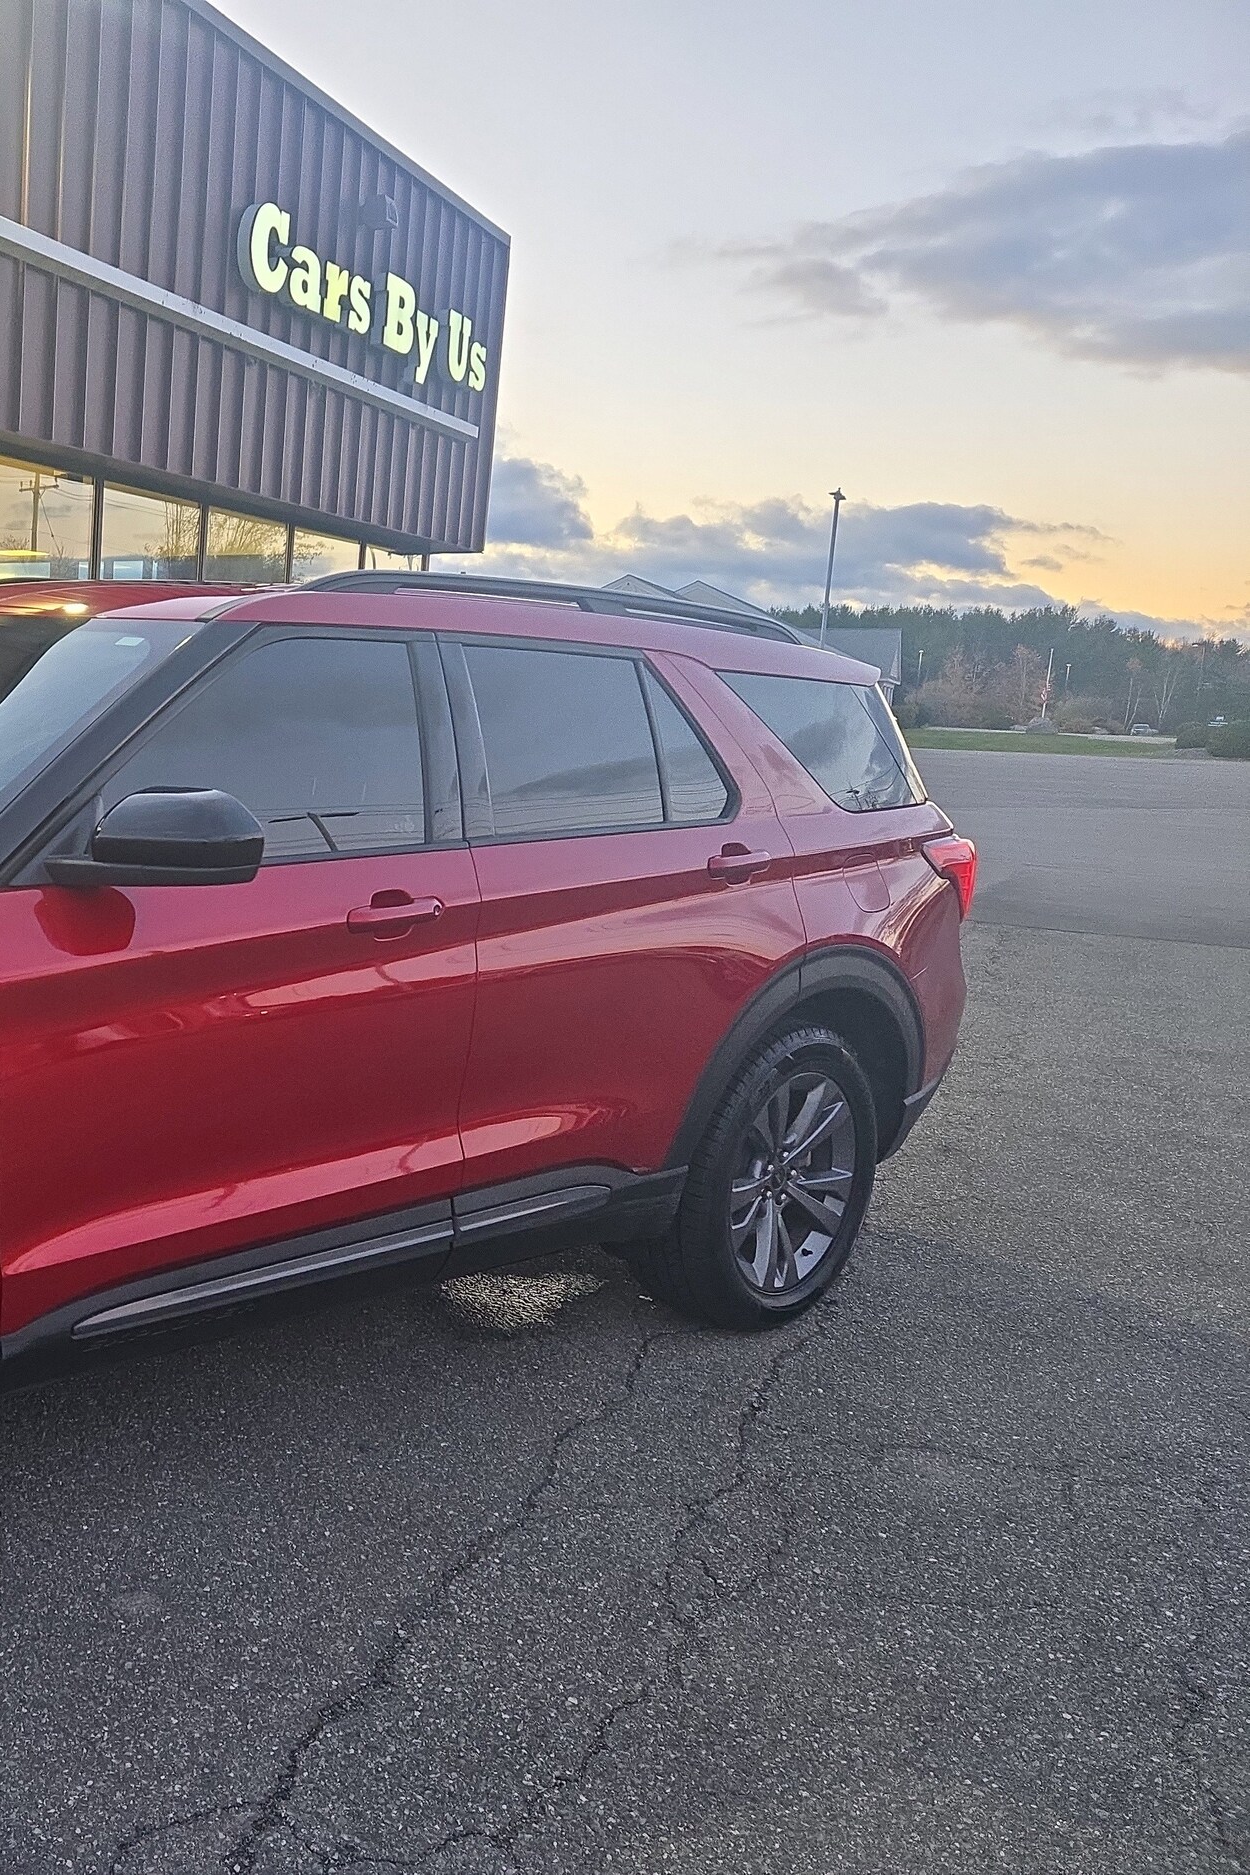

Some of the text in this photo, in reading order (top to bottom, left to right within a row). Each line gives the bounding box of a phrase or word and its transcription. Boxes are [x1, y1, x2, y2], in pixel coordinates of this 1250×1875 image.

[250, 201, 487, 392] Cars By Us
